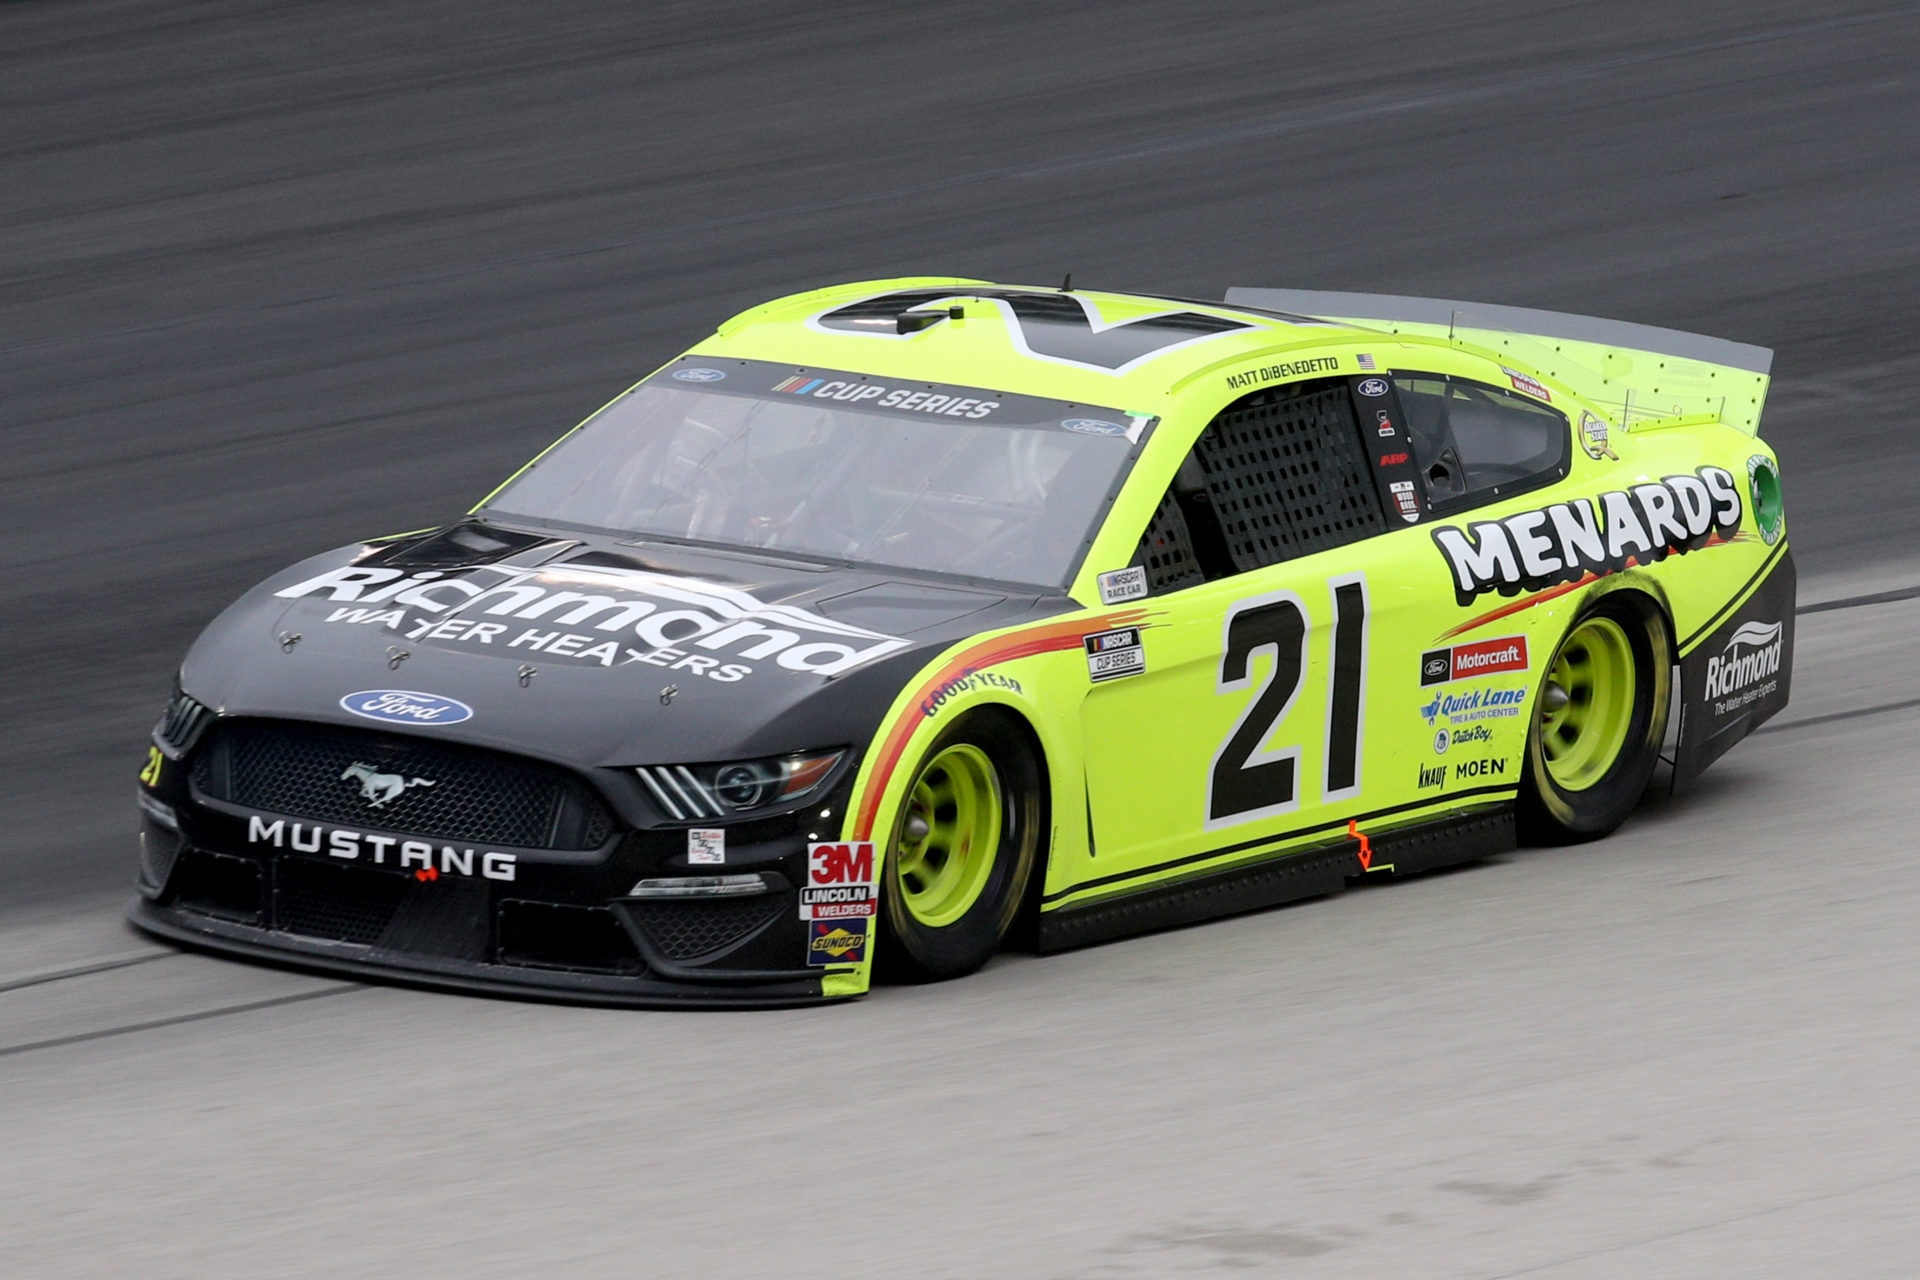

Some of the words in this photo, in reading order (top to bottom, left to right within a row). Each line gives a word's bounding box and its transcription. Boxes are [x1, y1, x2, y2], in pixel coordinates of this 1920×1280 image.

[1226, 370, 1259, 390] MATT
[1259, 356, 1339, 382] DiBENEDETTO
[813, 381, 886, 402] CUP
[877, 389, 1000, 419] SERIES
[1513, 380, 1549, 401] WELDERS
[1590, 430, 1608, 442] STATE
[1380, 452, 1409, 467] ARP
[1433, 465, 1742, 596] MENARDS
[1107, 586, 1126, 599] RACE
[1127, 583, 1142, 594] CAR
[274, 565, 909, 677] Richmond
[1102, 631, 1133, 649] NASCAR
[1096, 656, 1111, 671] CUP
[1111, 651, 1137, 668] SERIES
[1456, 645, 1521, 671] Motorcraft
[1703, 621, 1782, 702] Richmond
[1206, 575, 1368, 828] 21
[1441, 689, 1482, 716] Quick
[1481, 687, 1526, 707] Lane
[1714, 701, 1726, 716] The
[1450, 715, 1464, 725] TIRE
[1469, 710, 1487, 721] AUTO
[1487, 706, 1519, 718] CENTER
[139, 746, 163, 788] 21
[1455, 757, 1505, 780] MOEN
[248, 815, 517, 882] MUSTANG
[811, 844, 873, 884] 3M
[803, 886, 867, 904] LINCOLN
[817, 903, 872, 917] WELDERS
[813, 935, 862, 950] SUNOCO
